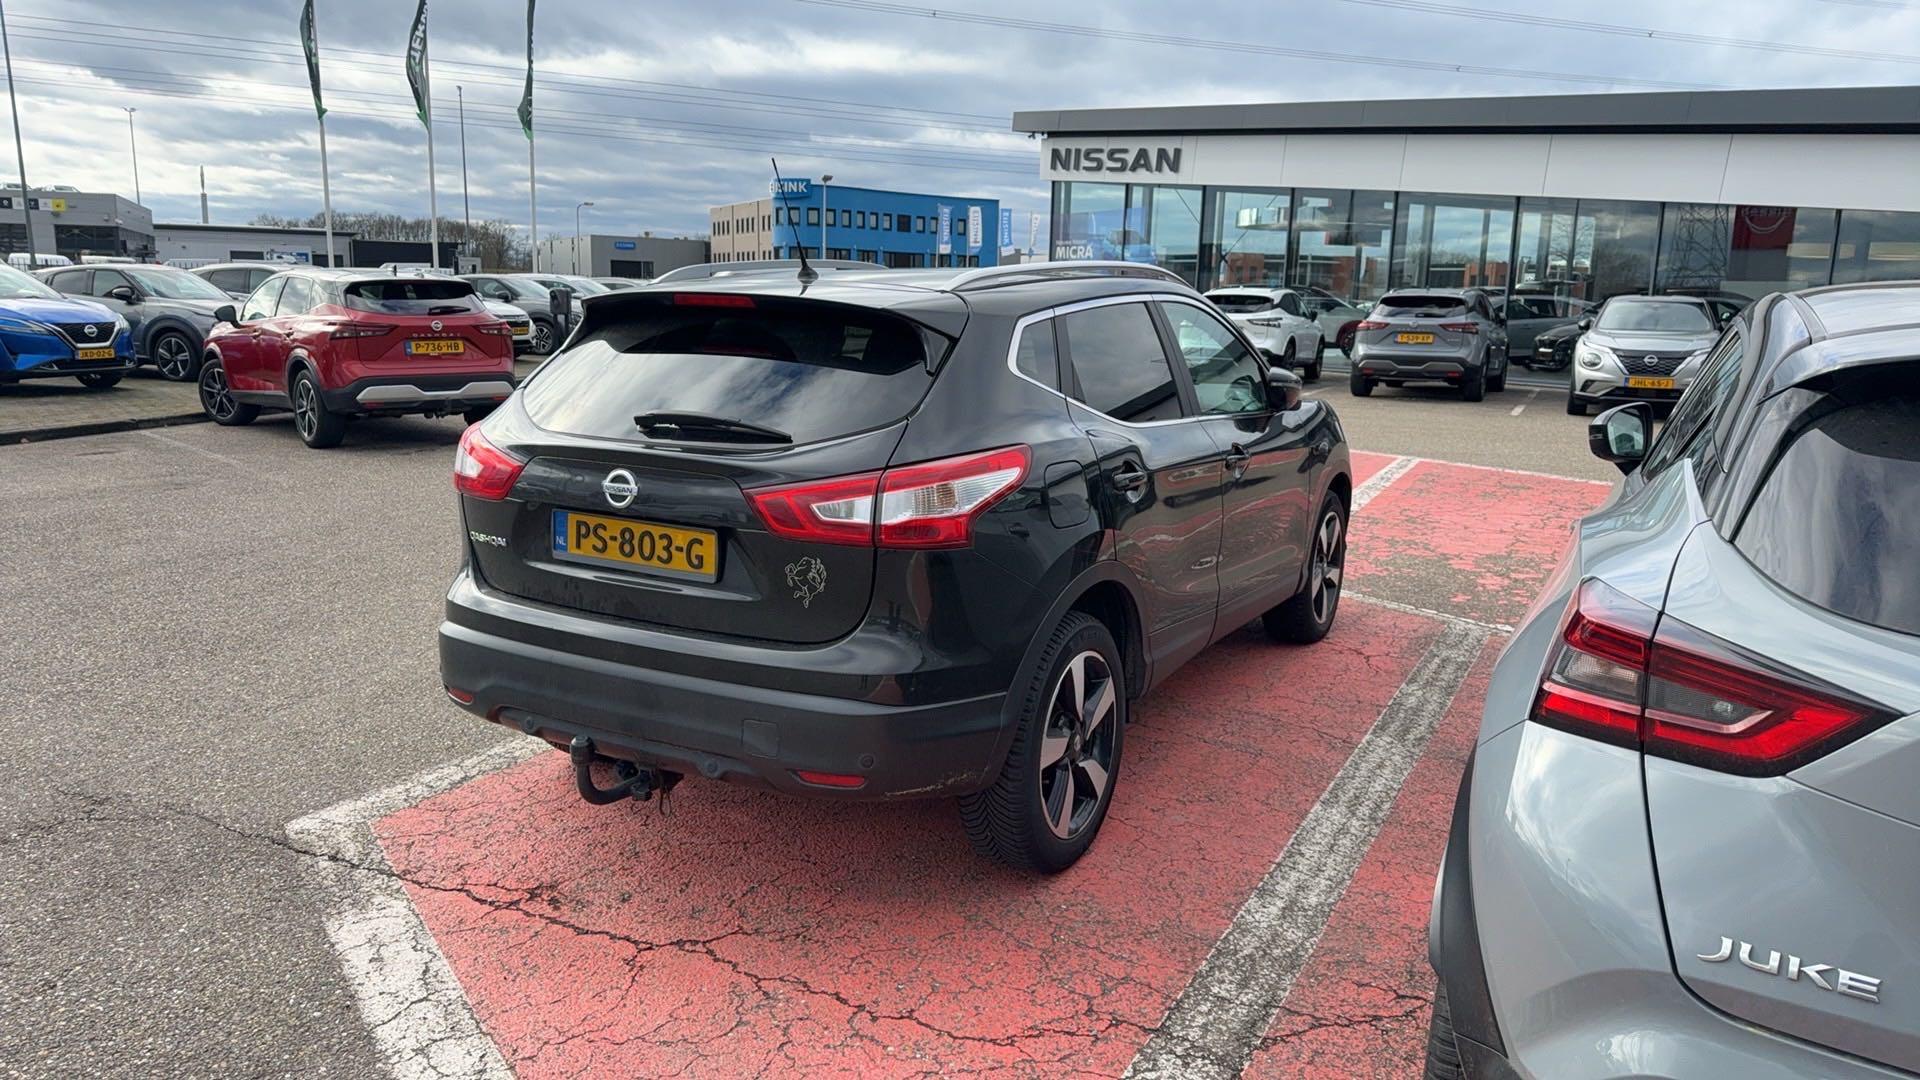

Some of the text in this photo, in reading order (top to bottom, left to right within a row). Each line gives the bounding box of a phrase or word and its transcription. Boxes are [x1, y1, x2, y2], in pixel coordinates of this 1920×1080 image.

[1050, 147, 1182, 173] NISSAN
[1055, 246, 1094, 260] MICRA
[415, 342, 460, 352] P-736-HB
[604, 484, 633, 494] NISSAN
[470, 531, 507, 547] QASHQAI
[556, 519, 706, 571] NL PS-803-G
[1697, 935, 1882, 1004] JUKE
